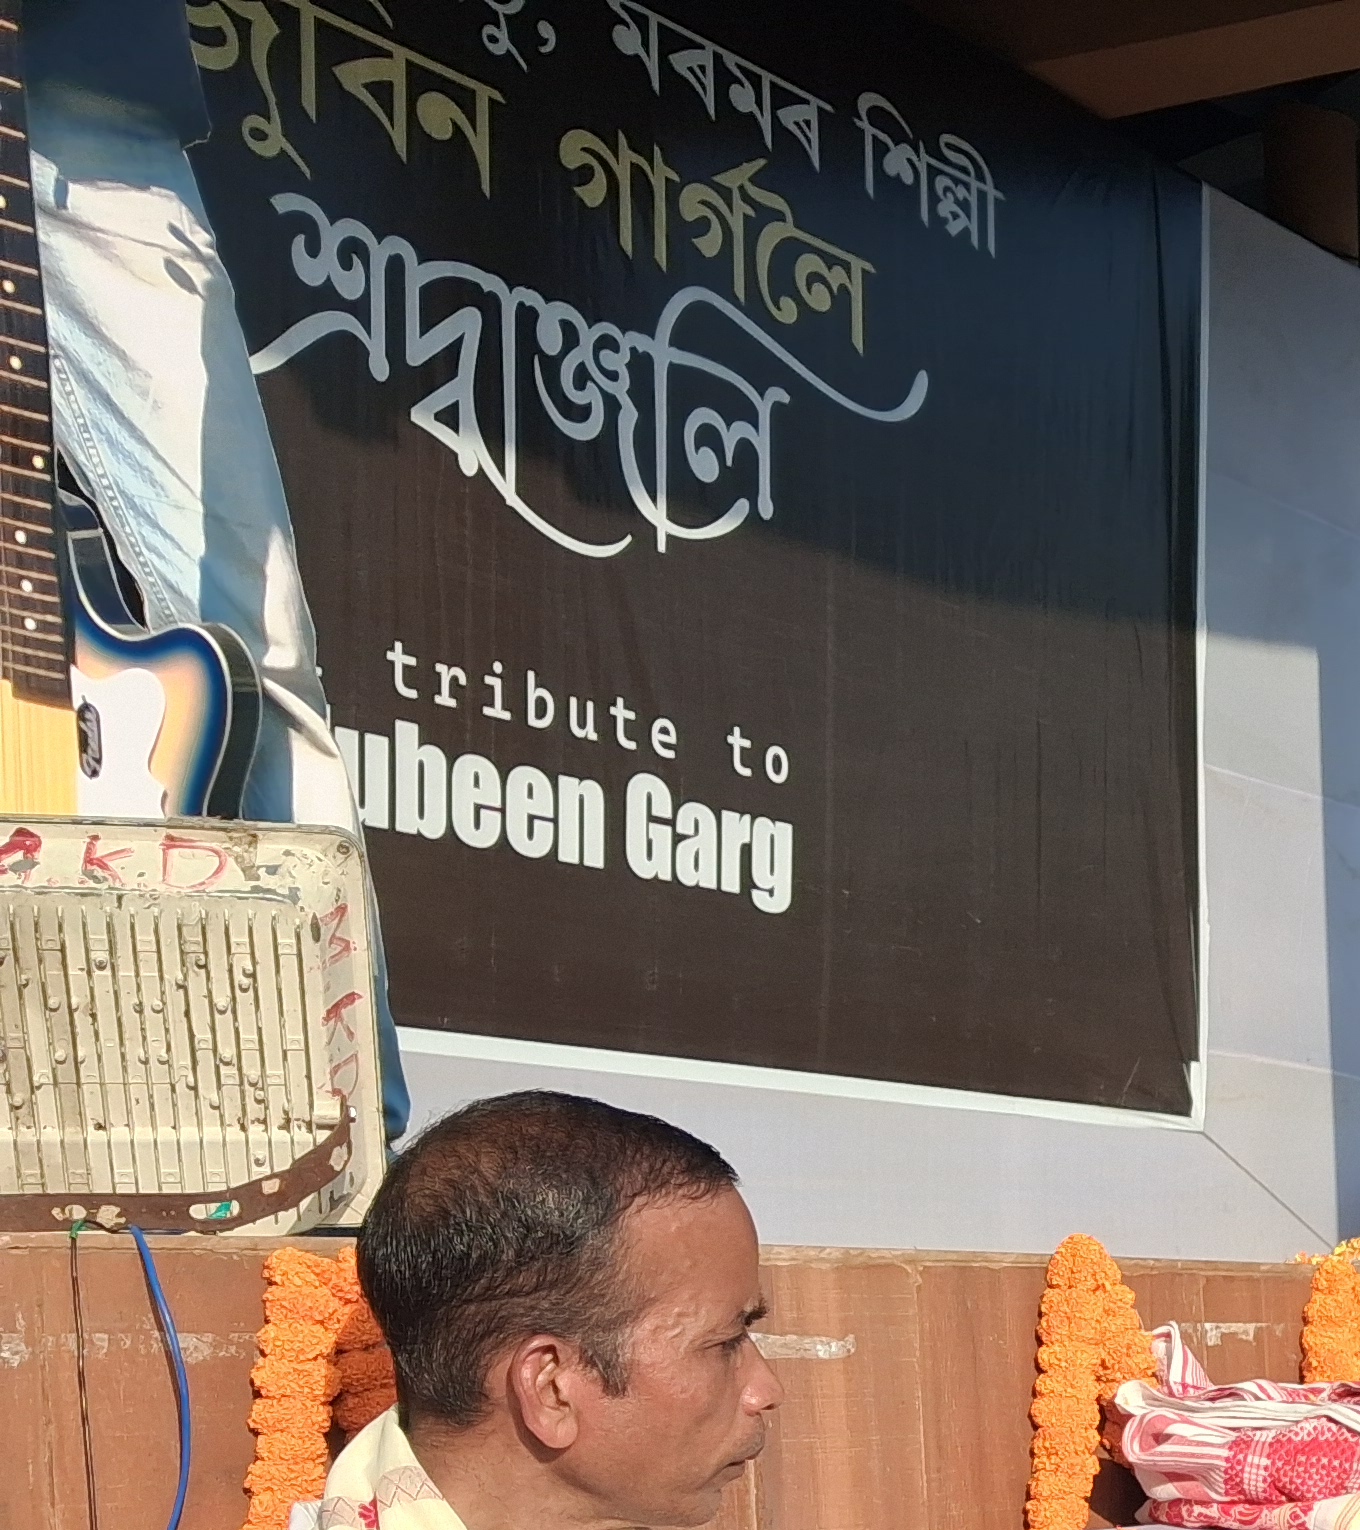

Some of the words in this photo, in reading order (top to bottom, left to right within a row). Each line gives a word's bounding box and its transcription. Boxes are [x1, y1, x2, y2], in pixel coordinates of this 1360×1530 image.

[853, 92, 1005, 258] শিল্পী
[386, 640, 678, 760] tribute
[727, 726, 789, 784] to
[326, 703, 605, 869] ubeen
[626, 771, 793, 915] Garg
